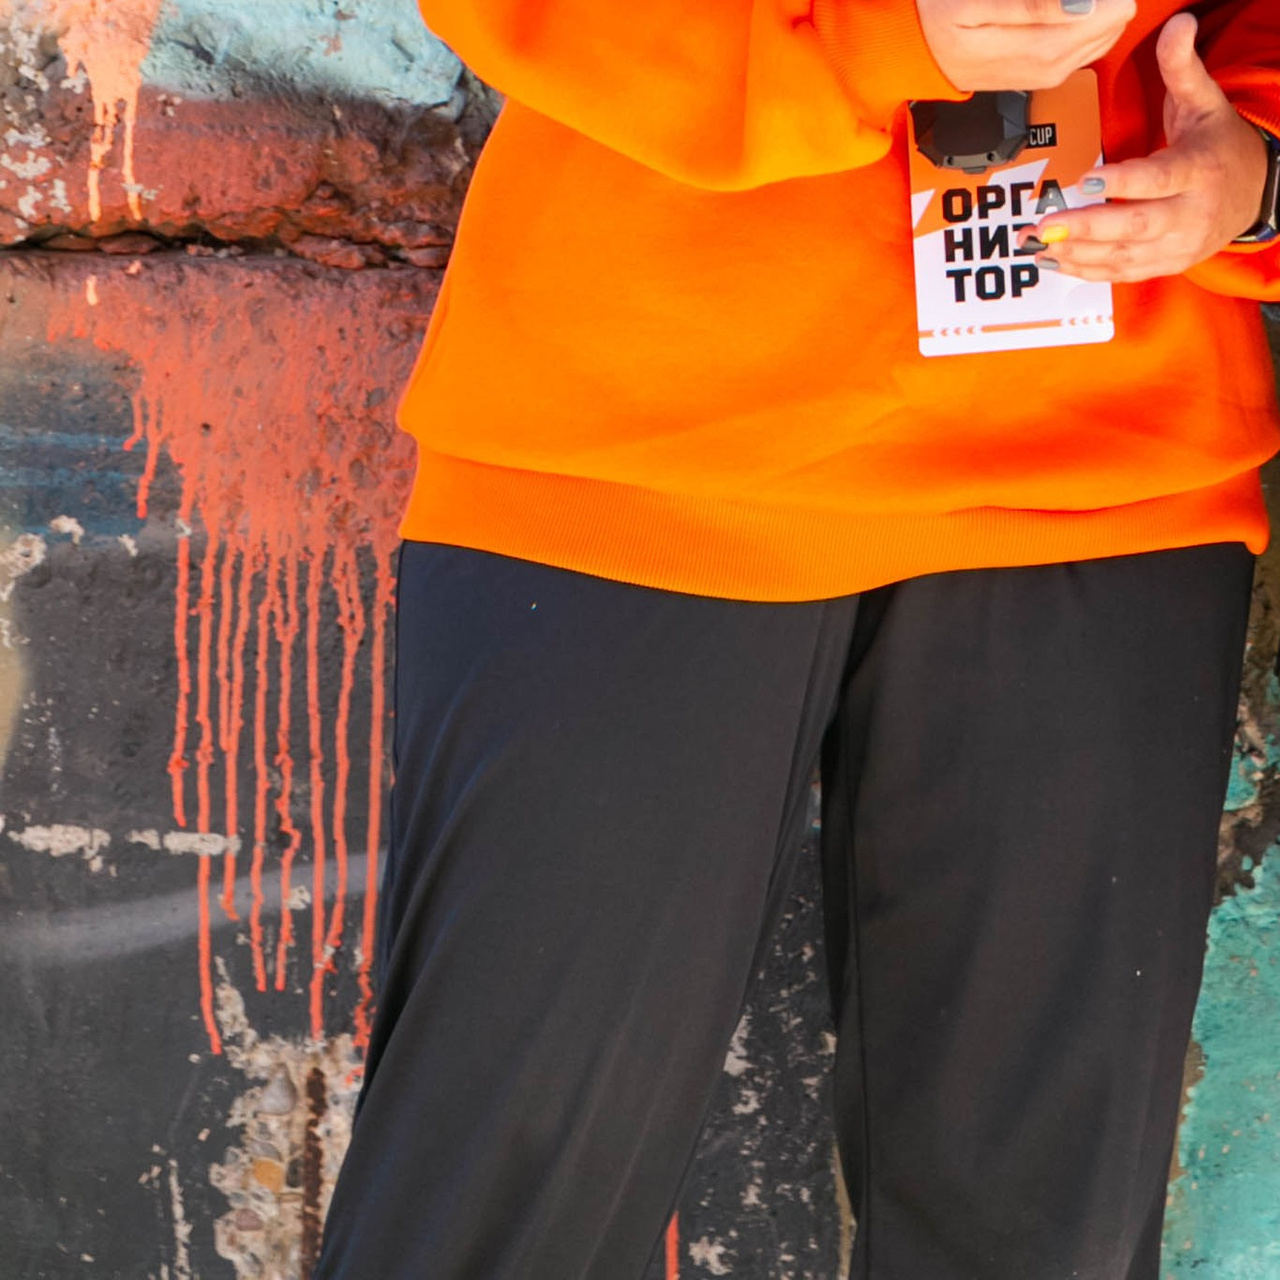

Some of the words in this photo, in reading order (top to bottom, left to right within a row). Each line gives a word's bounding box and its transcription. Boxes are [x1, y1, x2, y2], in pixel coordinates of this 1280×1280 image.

[1029, 127, 1053, 146] CUP
[942, 179, 1068, 223] ОРГА
[946, 263, 1039, 302] ТОР
